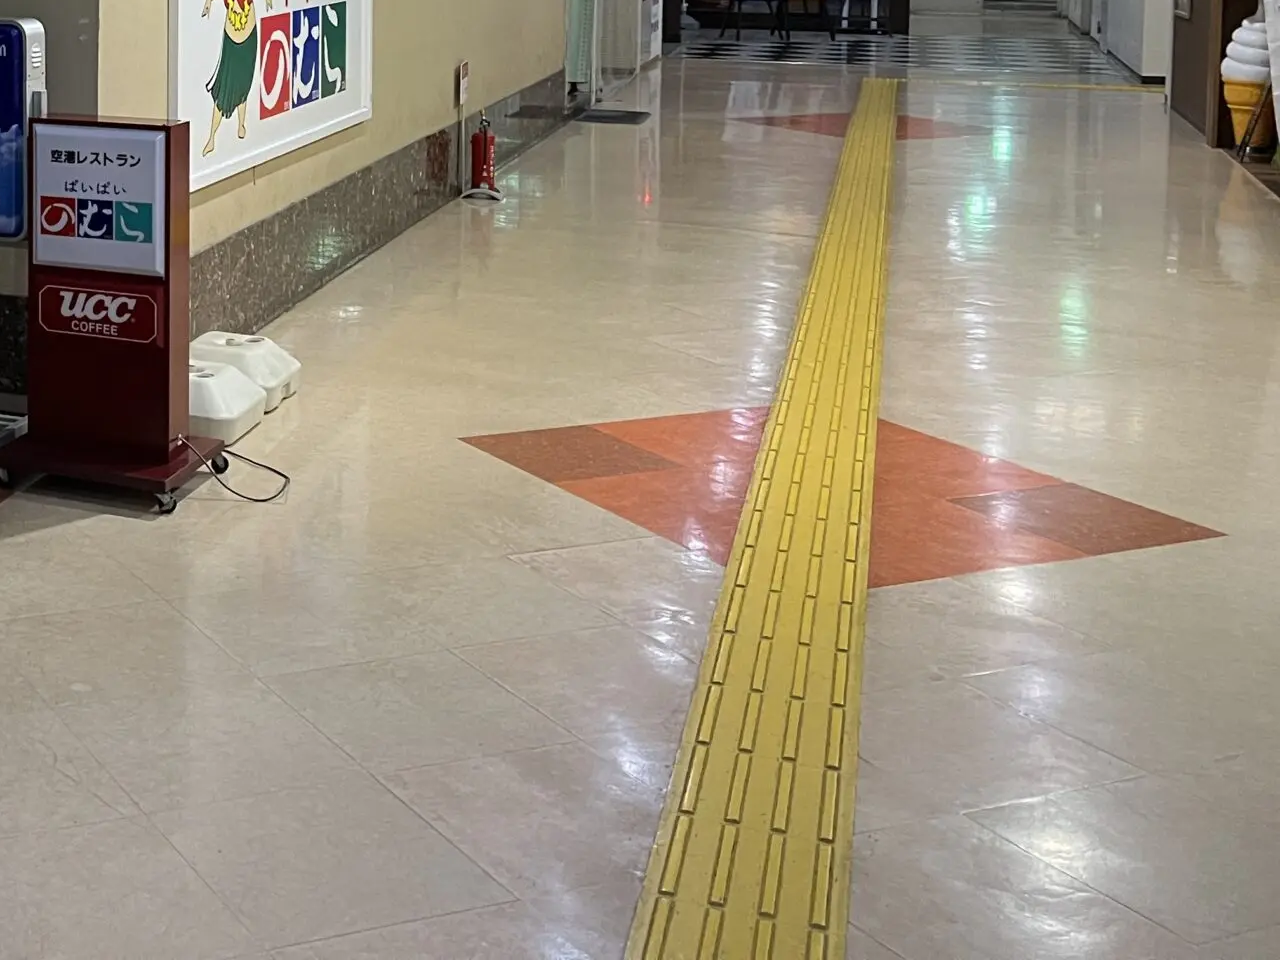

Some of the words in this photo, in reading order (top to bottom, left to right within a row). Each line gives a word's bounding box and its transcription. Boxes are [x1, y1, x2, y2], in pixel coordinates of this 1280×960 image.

[50, 149, 142, 168] 空港レストラン
[71, 320, 119, 337] COFFEE
